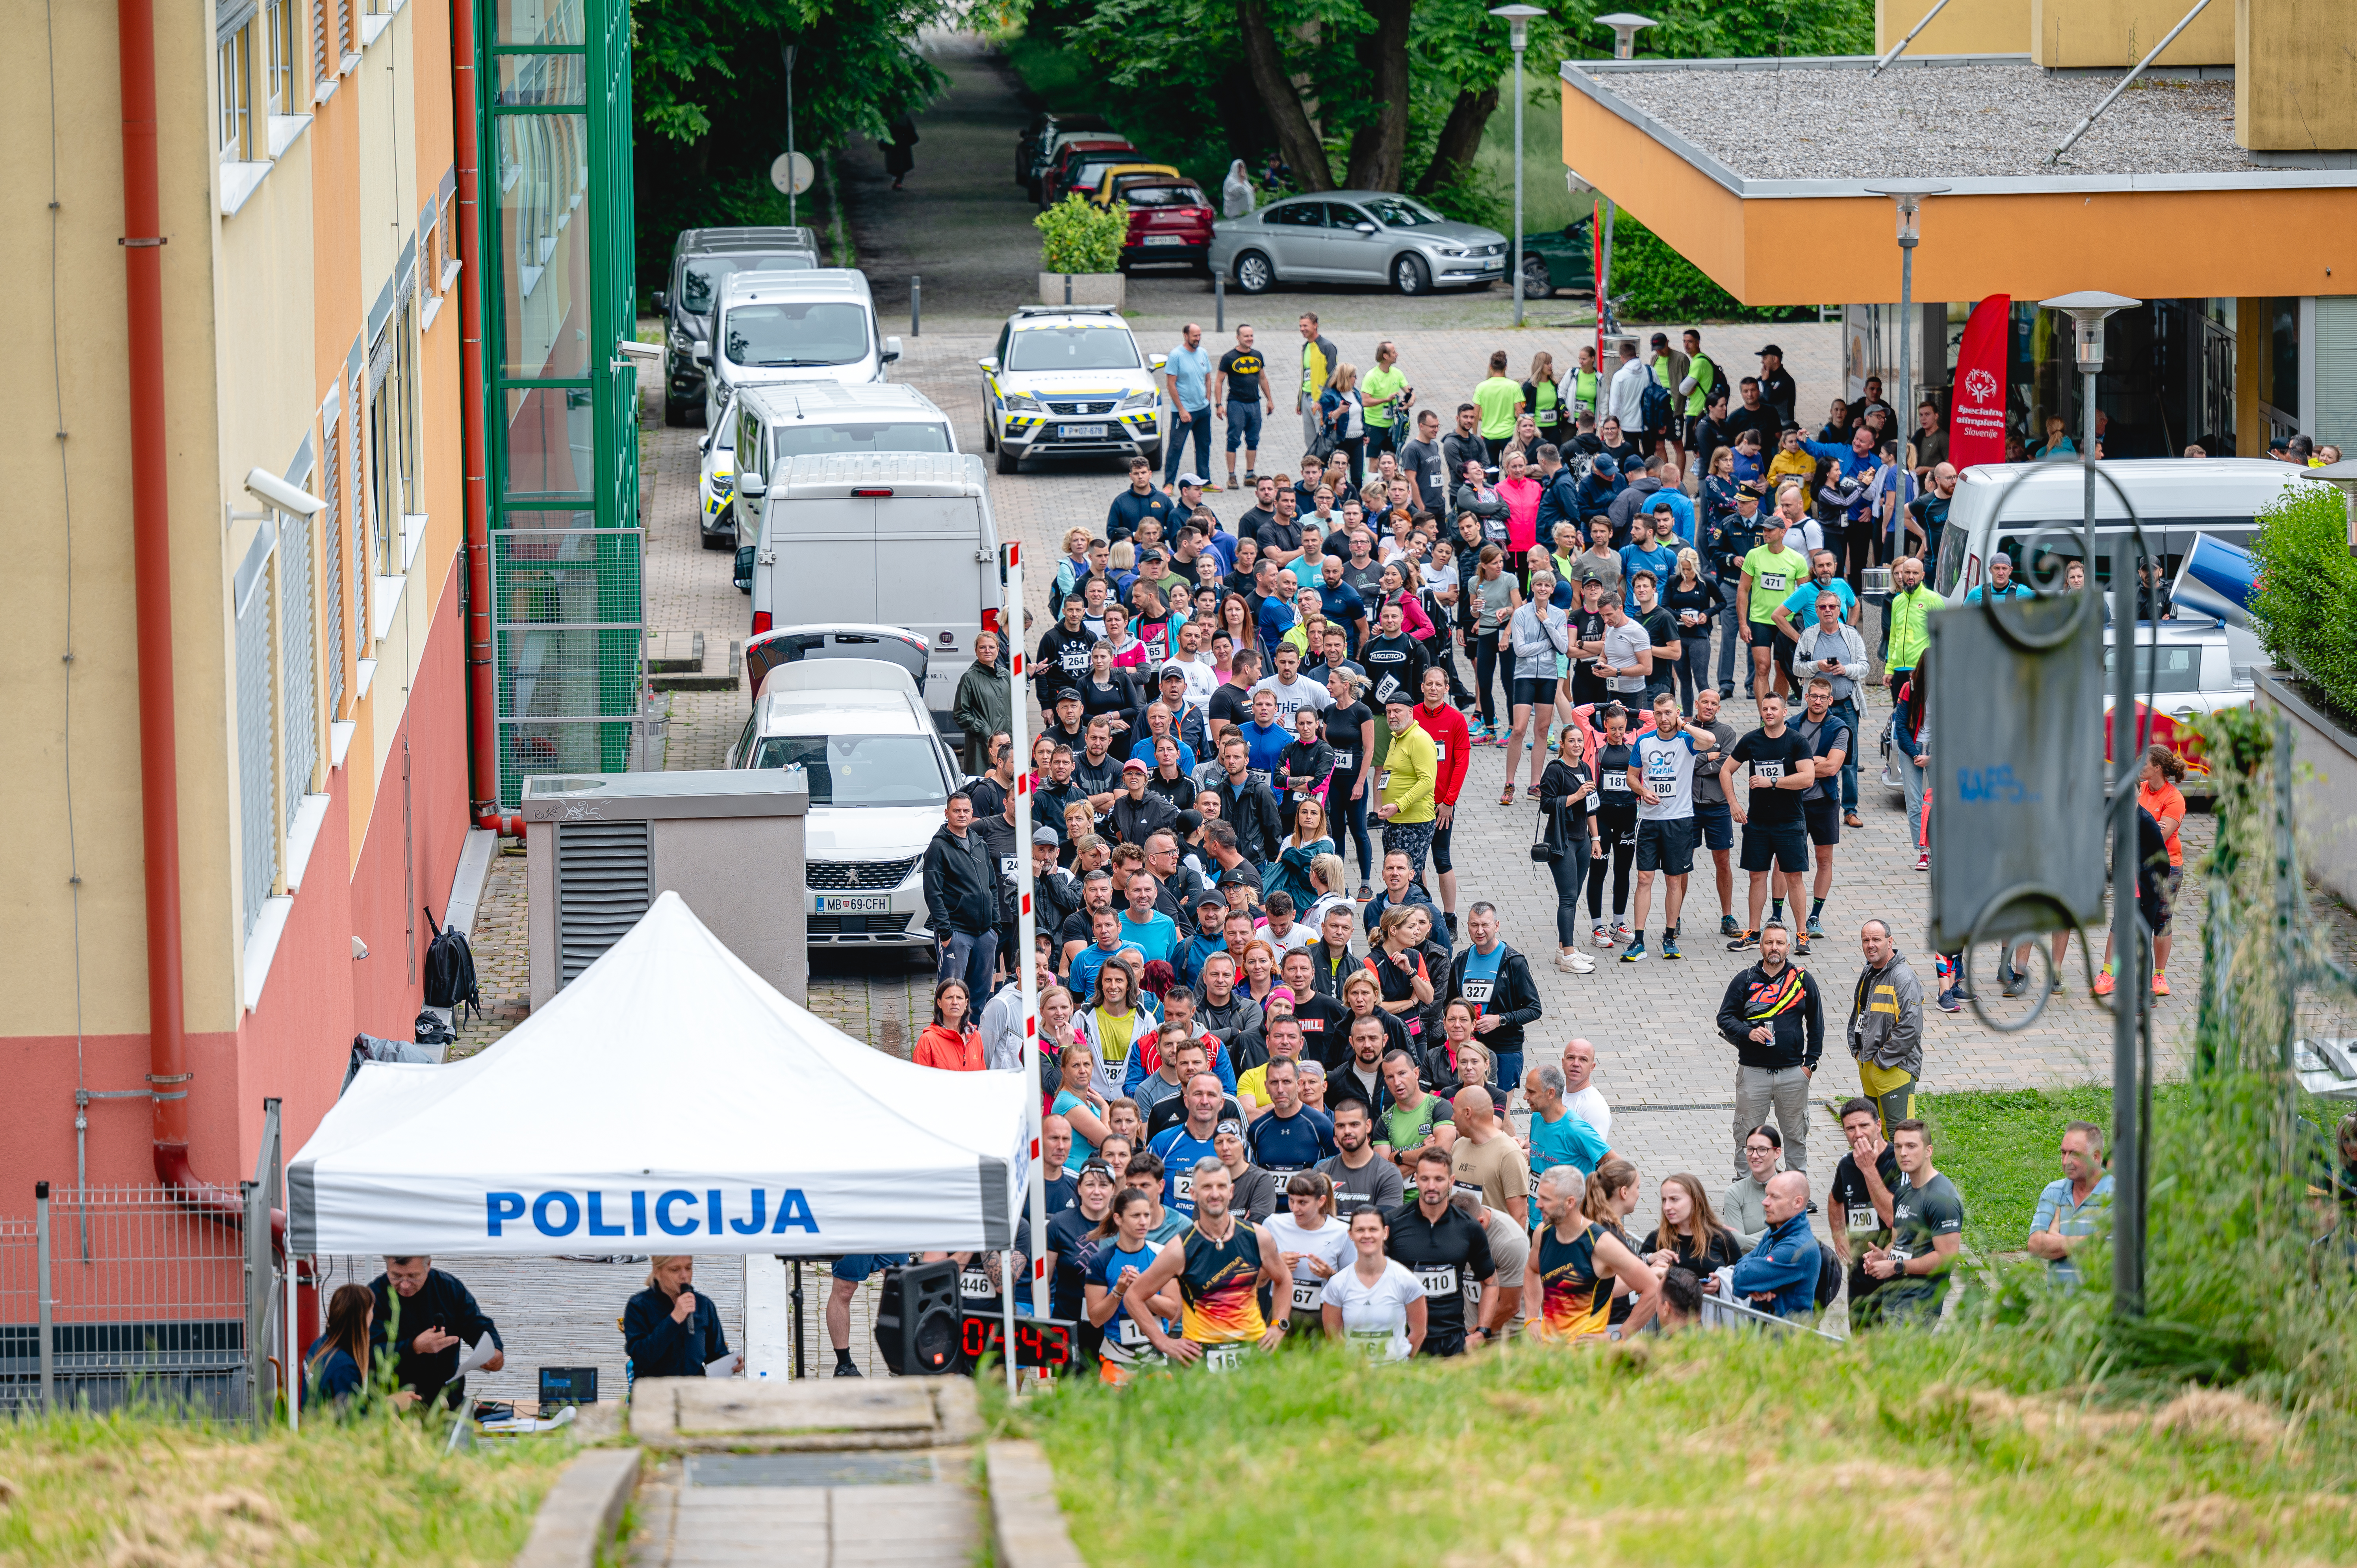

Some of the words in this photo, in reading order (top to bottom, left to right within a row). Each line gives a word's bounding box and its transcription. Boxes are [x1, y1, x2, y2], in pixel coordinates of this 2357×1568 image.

[1957, 405, 2003, 417] Specialna
[1956, 416, 2004, 429] olimpiada
[1963, 426, 1998, 439] Slovenije
[1764, 578, 1780, 587] 471
[1068, 657, 1084, 665] 264
[1379, 679, 1393, 696] 396
[1648, 765, 1675, 773] 4TRAIL
[1760, 766, 1778, 775] 182
[1609, 775, 1626, 786] 181
[1653, 782, 1671, 792] 180
[1589, 795, 1598, 807] 171
[827, 899, 842, 910] MB
[851, 898, 885, 910] 69-CFH
[1467, 986, 1487, 998] 327
[1749, 982, 1780, 1005] 72
[1458, 1161, 1469, 1171] HS
[486, 1188, 820, 1237] POLICIJA
[1853, 1210, 1872, 1225] 290
[1211, 1255, 1243, 1284] SPORTIVA
[1545, 1261, 1573, 1279] SPORTIVA
[960, 1276, 988, 1291] 446
[1422, 1273, 1449, 1288] 410
